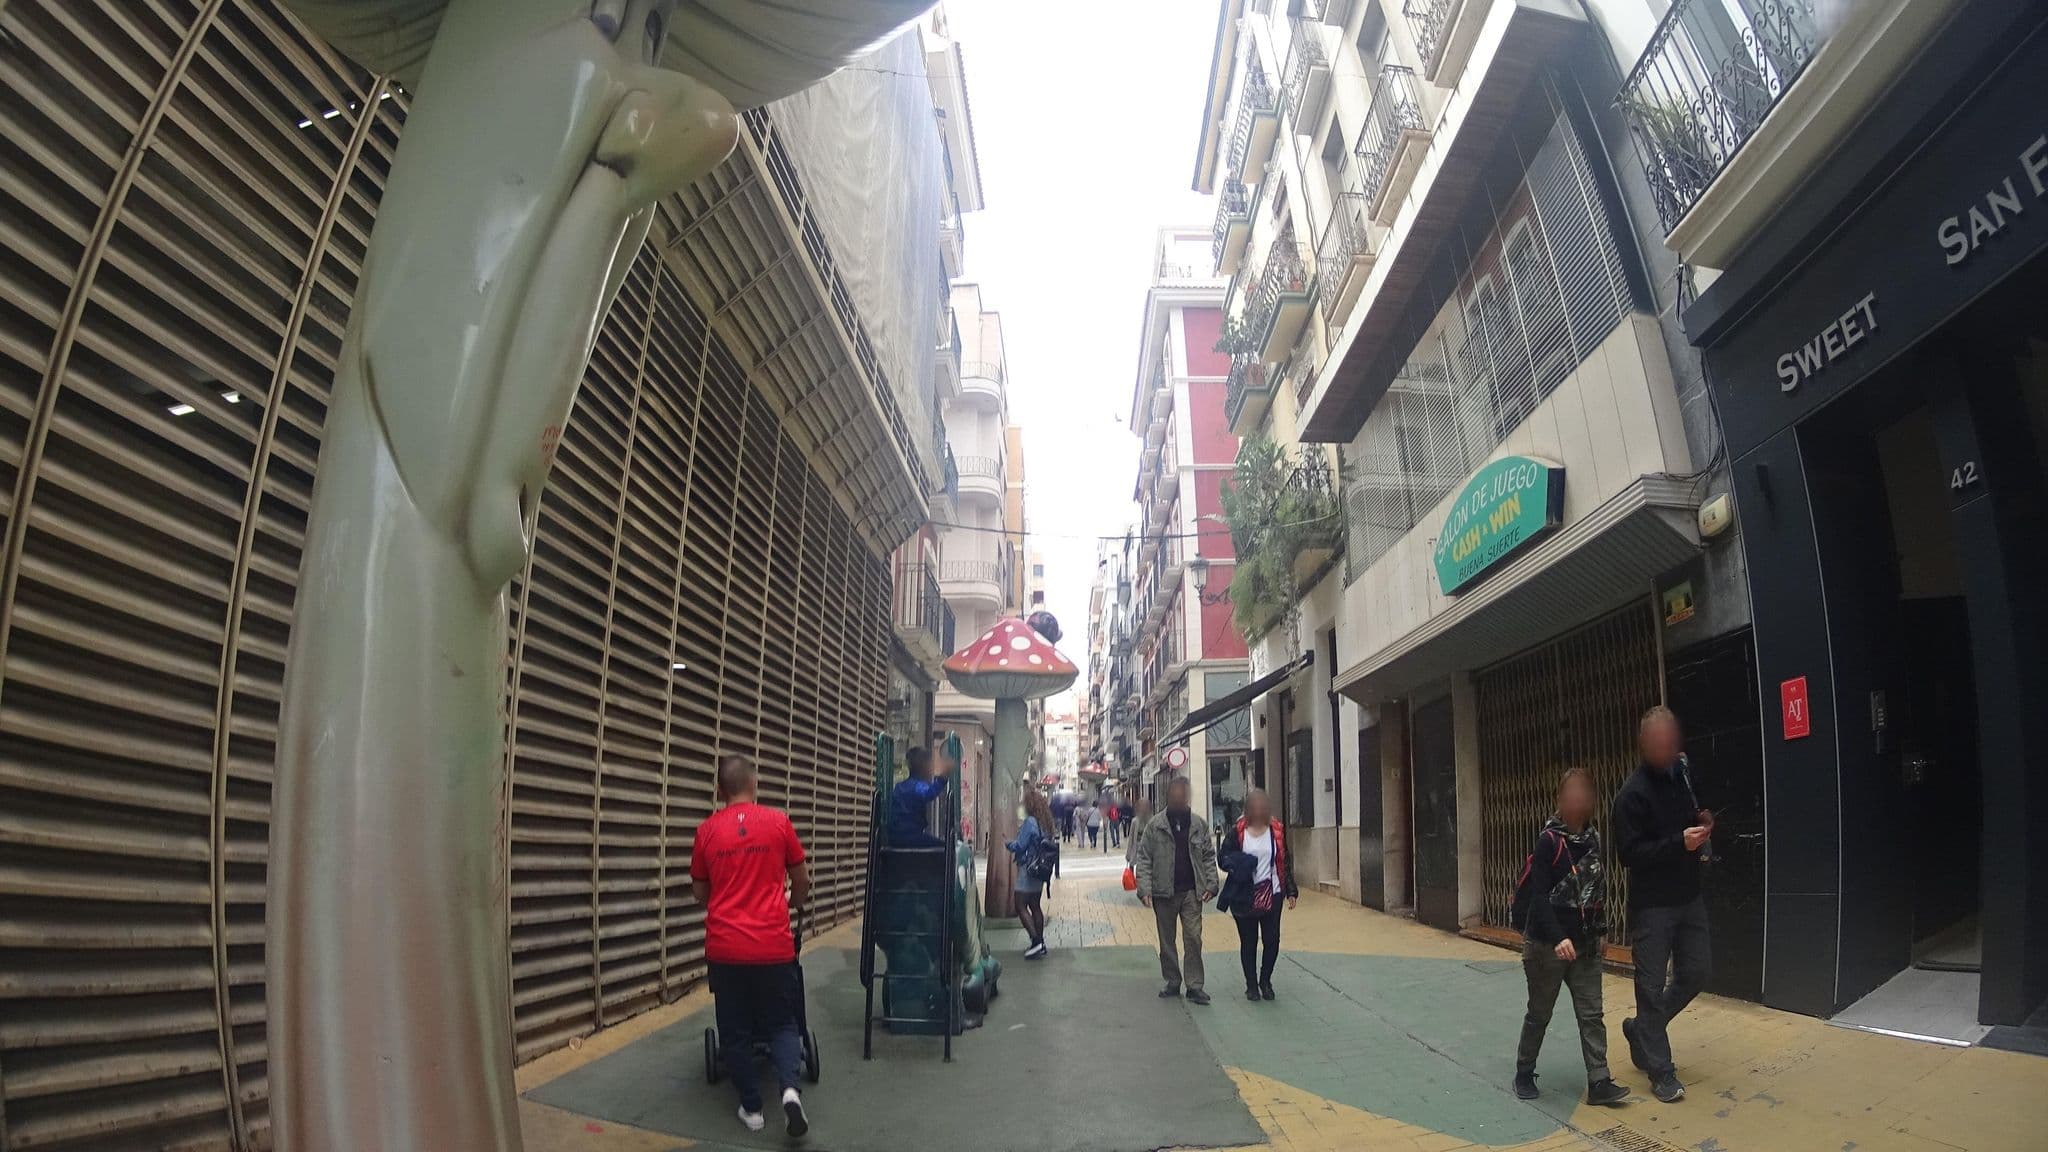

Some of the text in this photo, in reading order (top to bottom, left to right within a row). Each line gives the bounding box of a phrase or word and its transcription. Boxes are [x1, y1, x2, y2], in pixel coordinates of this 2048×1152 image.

[1776, 291, 1879, 392] SWEET
[1937, 176, 2024, 265] SAN
[1472, 483, 1488, 515] DE
[1490, 463, 1538, 502] JUEGO
[1950, 461, 1979, 489] 42
[1453, 492, 1521, 563] CASH WIN
[1459, 526, 1521, 582] BUENA SUERTE
